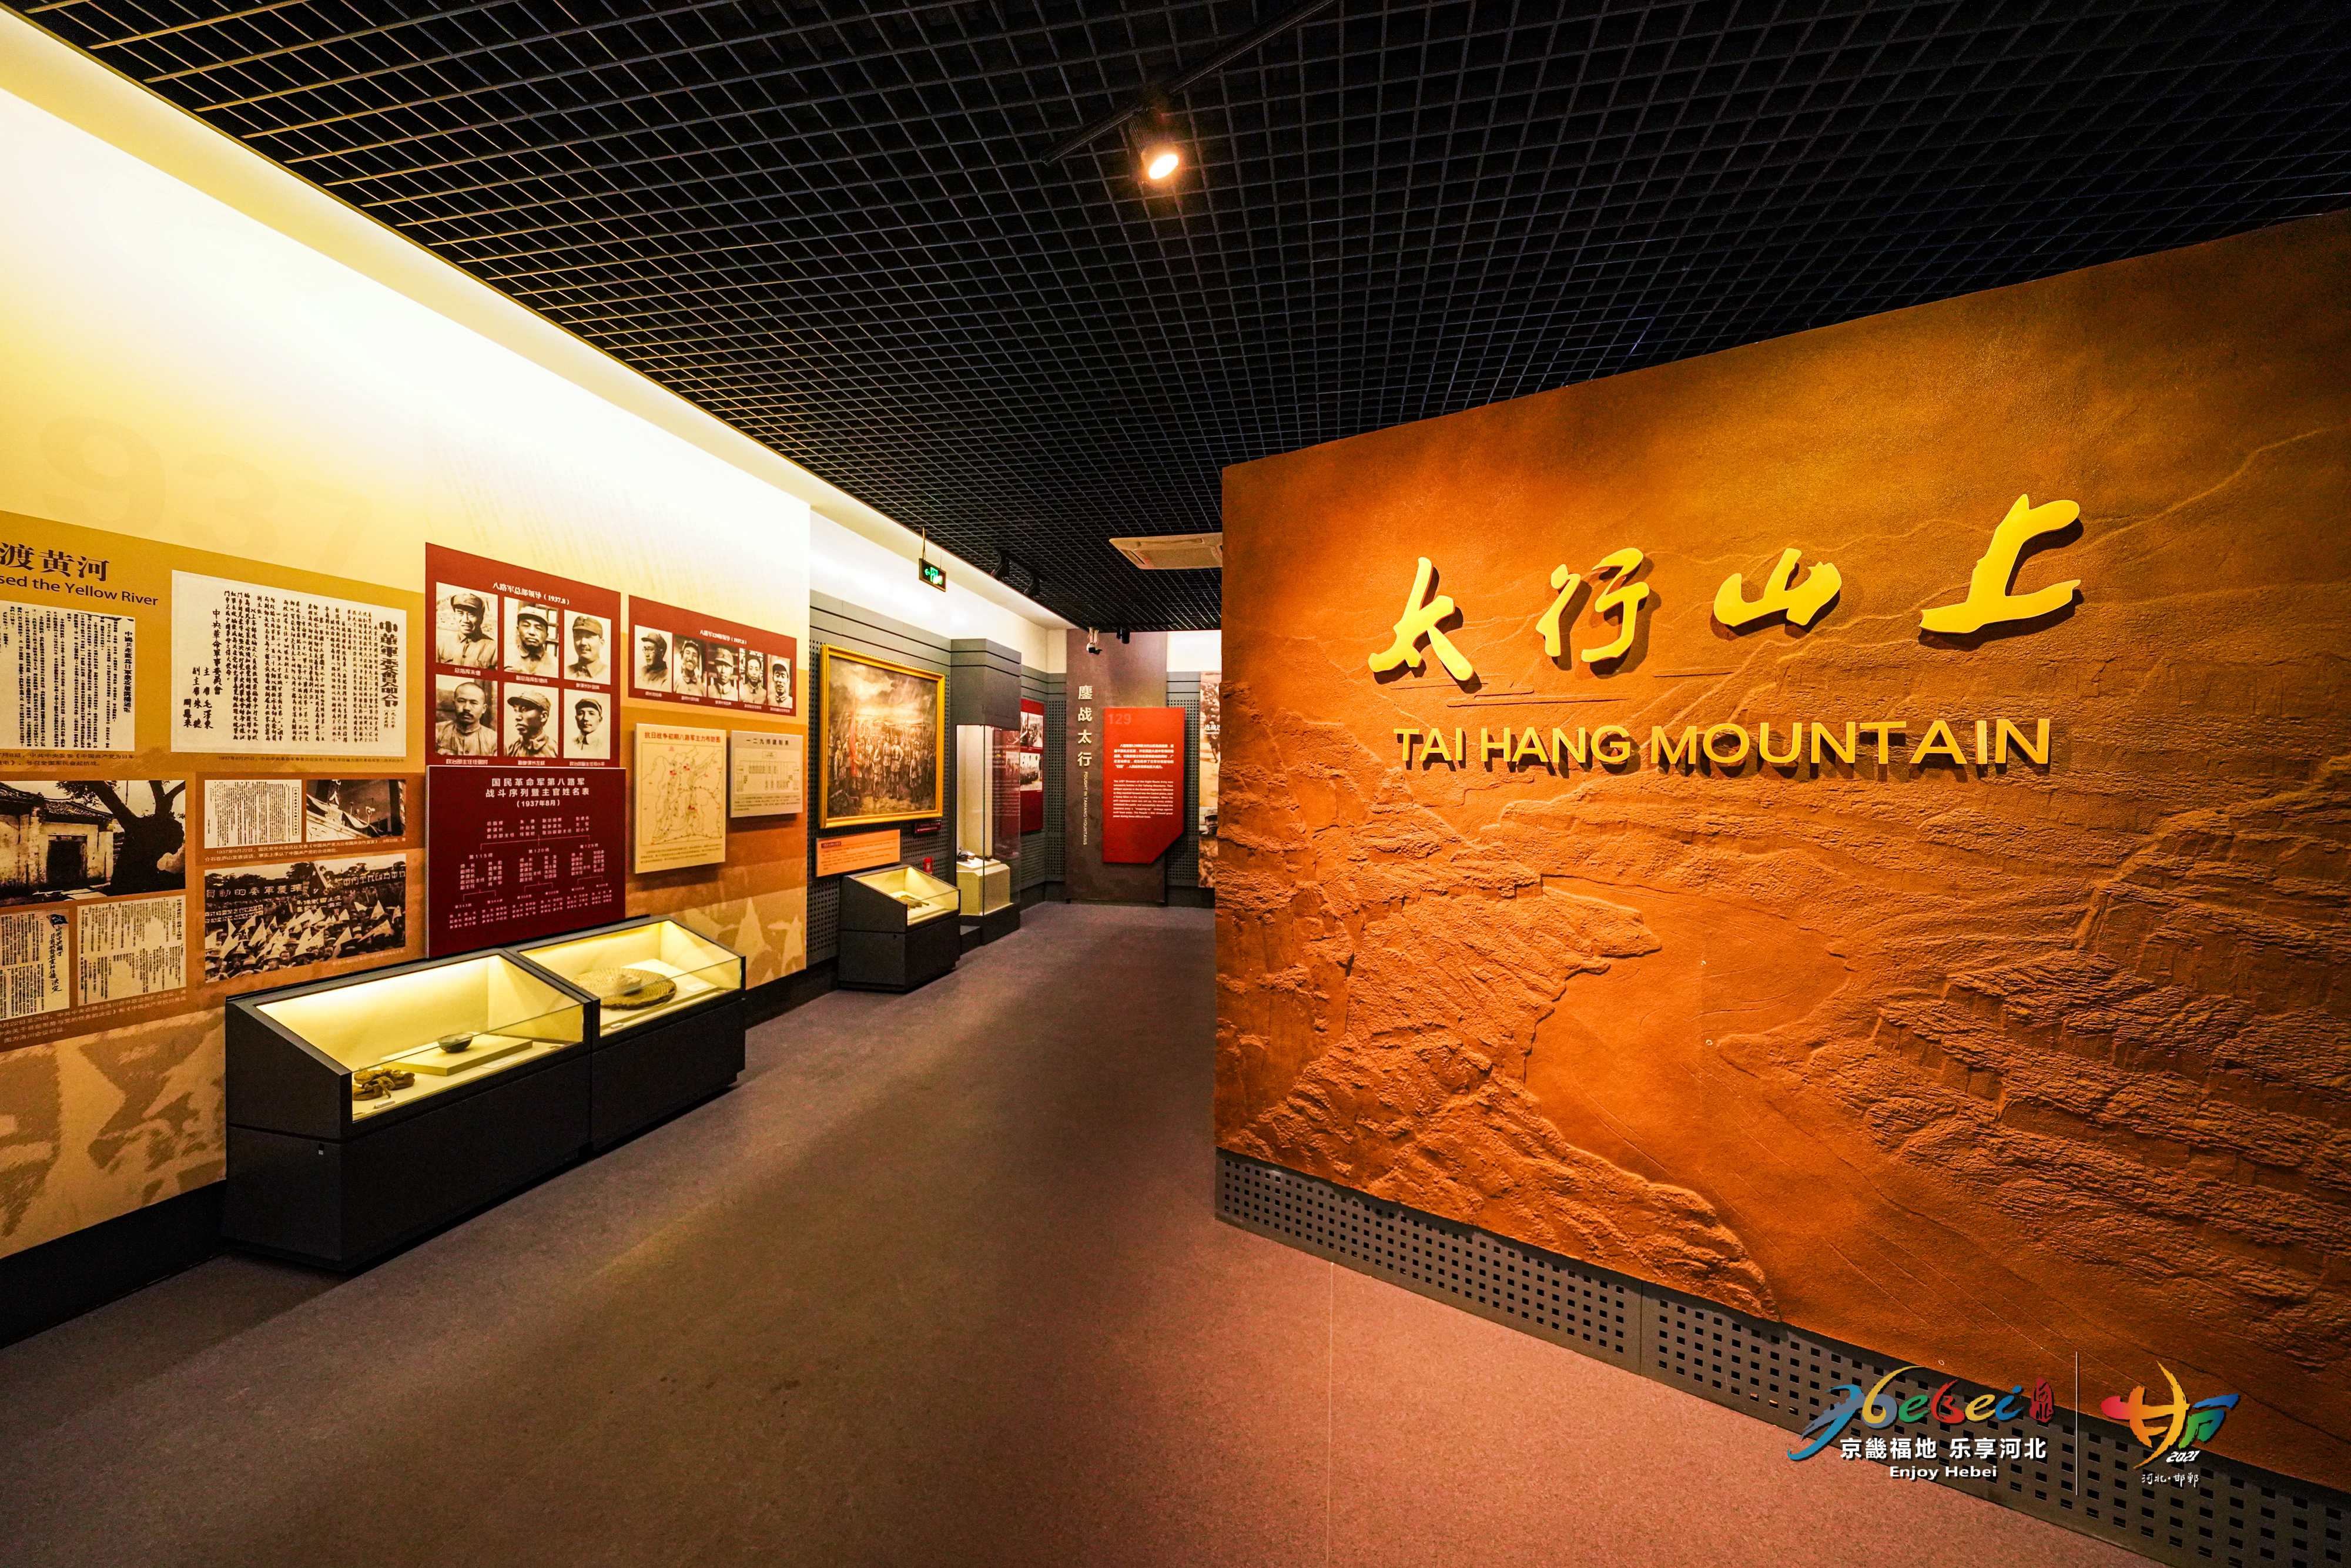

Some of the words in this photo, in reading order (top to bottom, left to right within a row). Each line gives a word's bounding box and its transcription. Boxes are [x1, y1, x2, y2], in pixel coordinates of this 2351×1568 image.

[32, 578, 60, 591] the
[65, 582, 118, 599] Yellow
[122, 591, 158, 606] River
[1368, 493, 2081, 682] 太行山上
[1108, 713, 1131, 725] 129
[1393, 728, 1464, 762] TAI
[1480, 725, 1632, 763] HANG
[1650, 718, 2050, 765] MOUNTAIN
[491, 778, 585, 787] 国民革命军第八路军
[485, 788, 590, 798] 战斗序列暨主官姓名表
